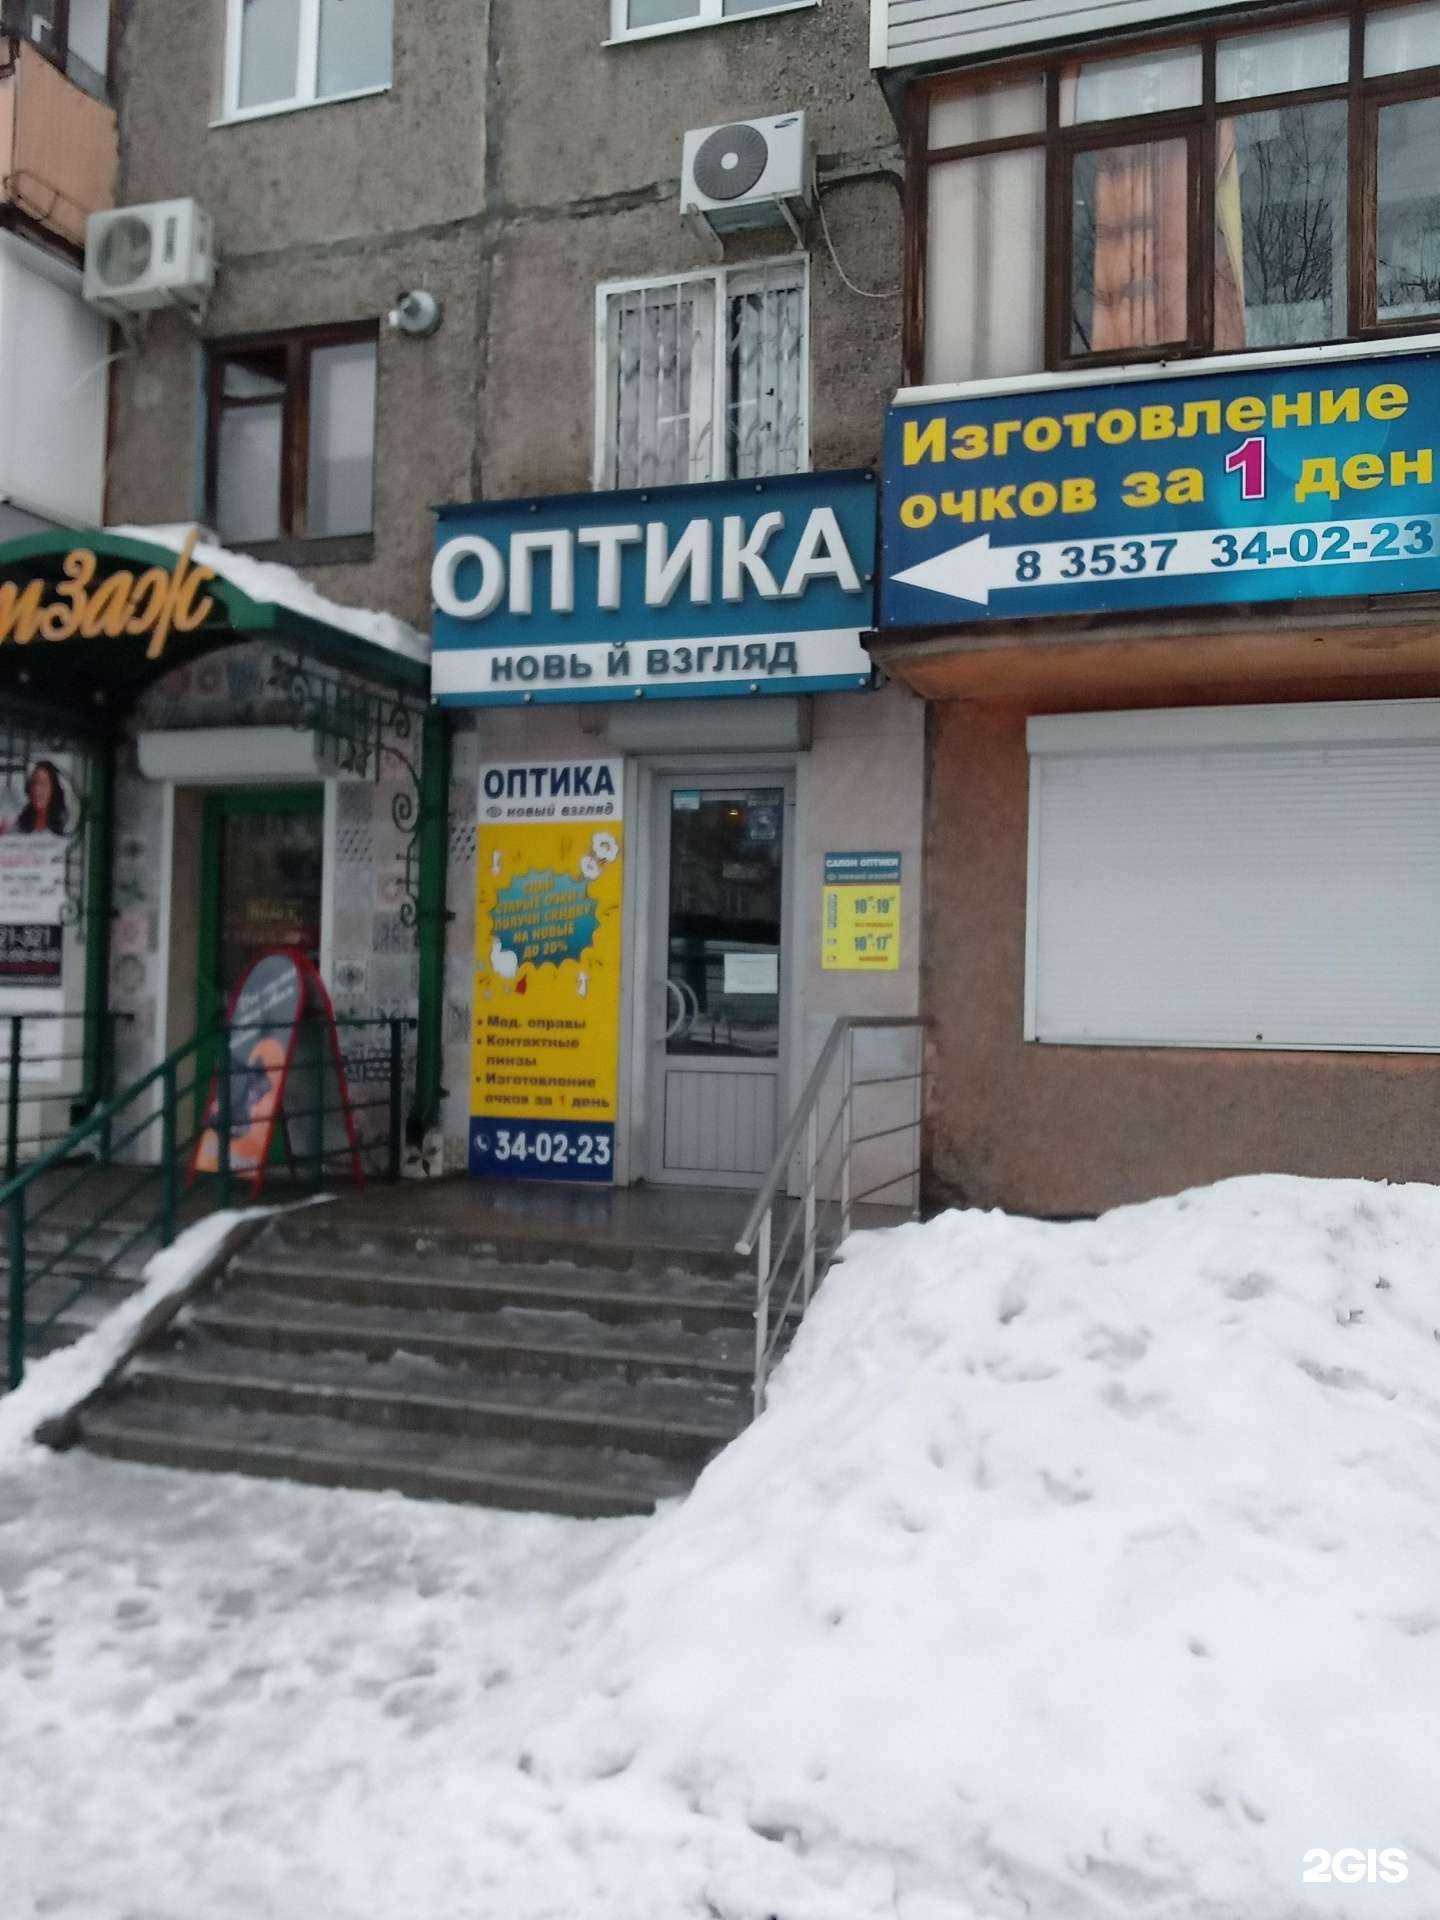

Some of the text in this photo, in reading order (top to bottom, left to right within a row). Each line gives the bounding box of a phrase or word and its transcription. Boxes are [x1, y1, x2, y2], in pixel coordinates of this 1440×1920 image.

[903, 383, 1409, 466] Изготовление
[900, 436, 1433, 529] очков за 1 ден
[431, 507, 864, 621] ОПТИКА
[1015, 519, 1435, 582] 8 3537 34-02-23
[647, 641, 798, 675] ВЗГЛЯД
[484, 765, 616, 799] ОПТИКА
[528, 1017, 586, 1031] оправы
[487, 1035, 580, 1049] Контактные
[486, 1073, 597, 1088] Изготовление
[485, 1094, 529, 1105] очков
[571, 1097, 609, 1108] день
[494, 1129, 611, 1165] 34-02-23
